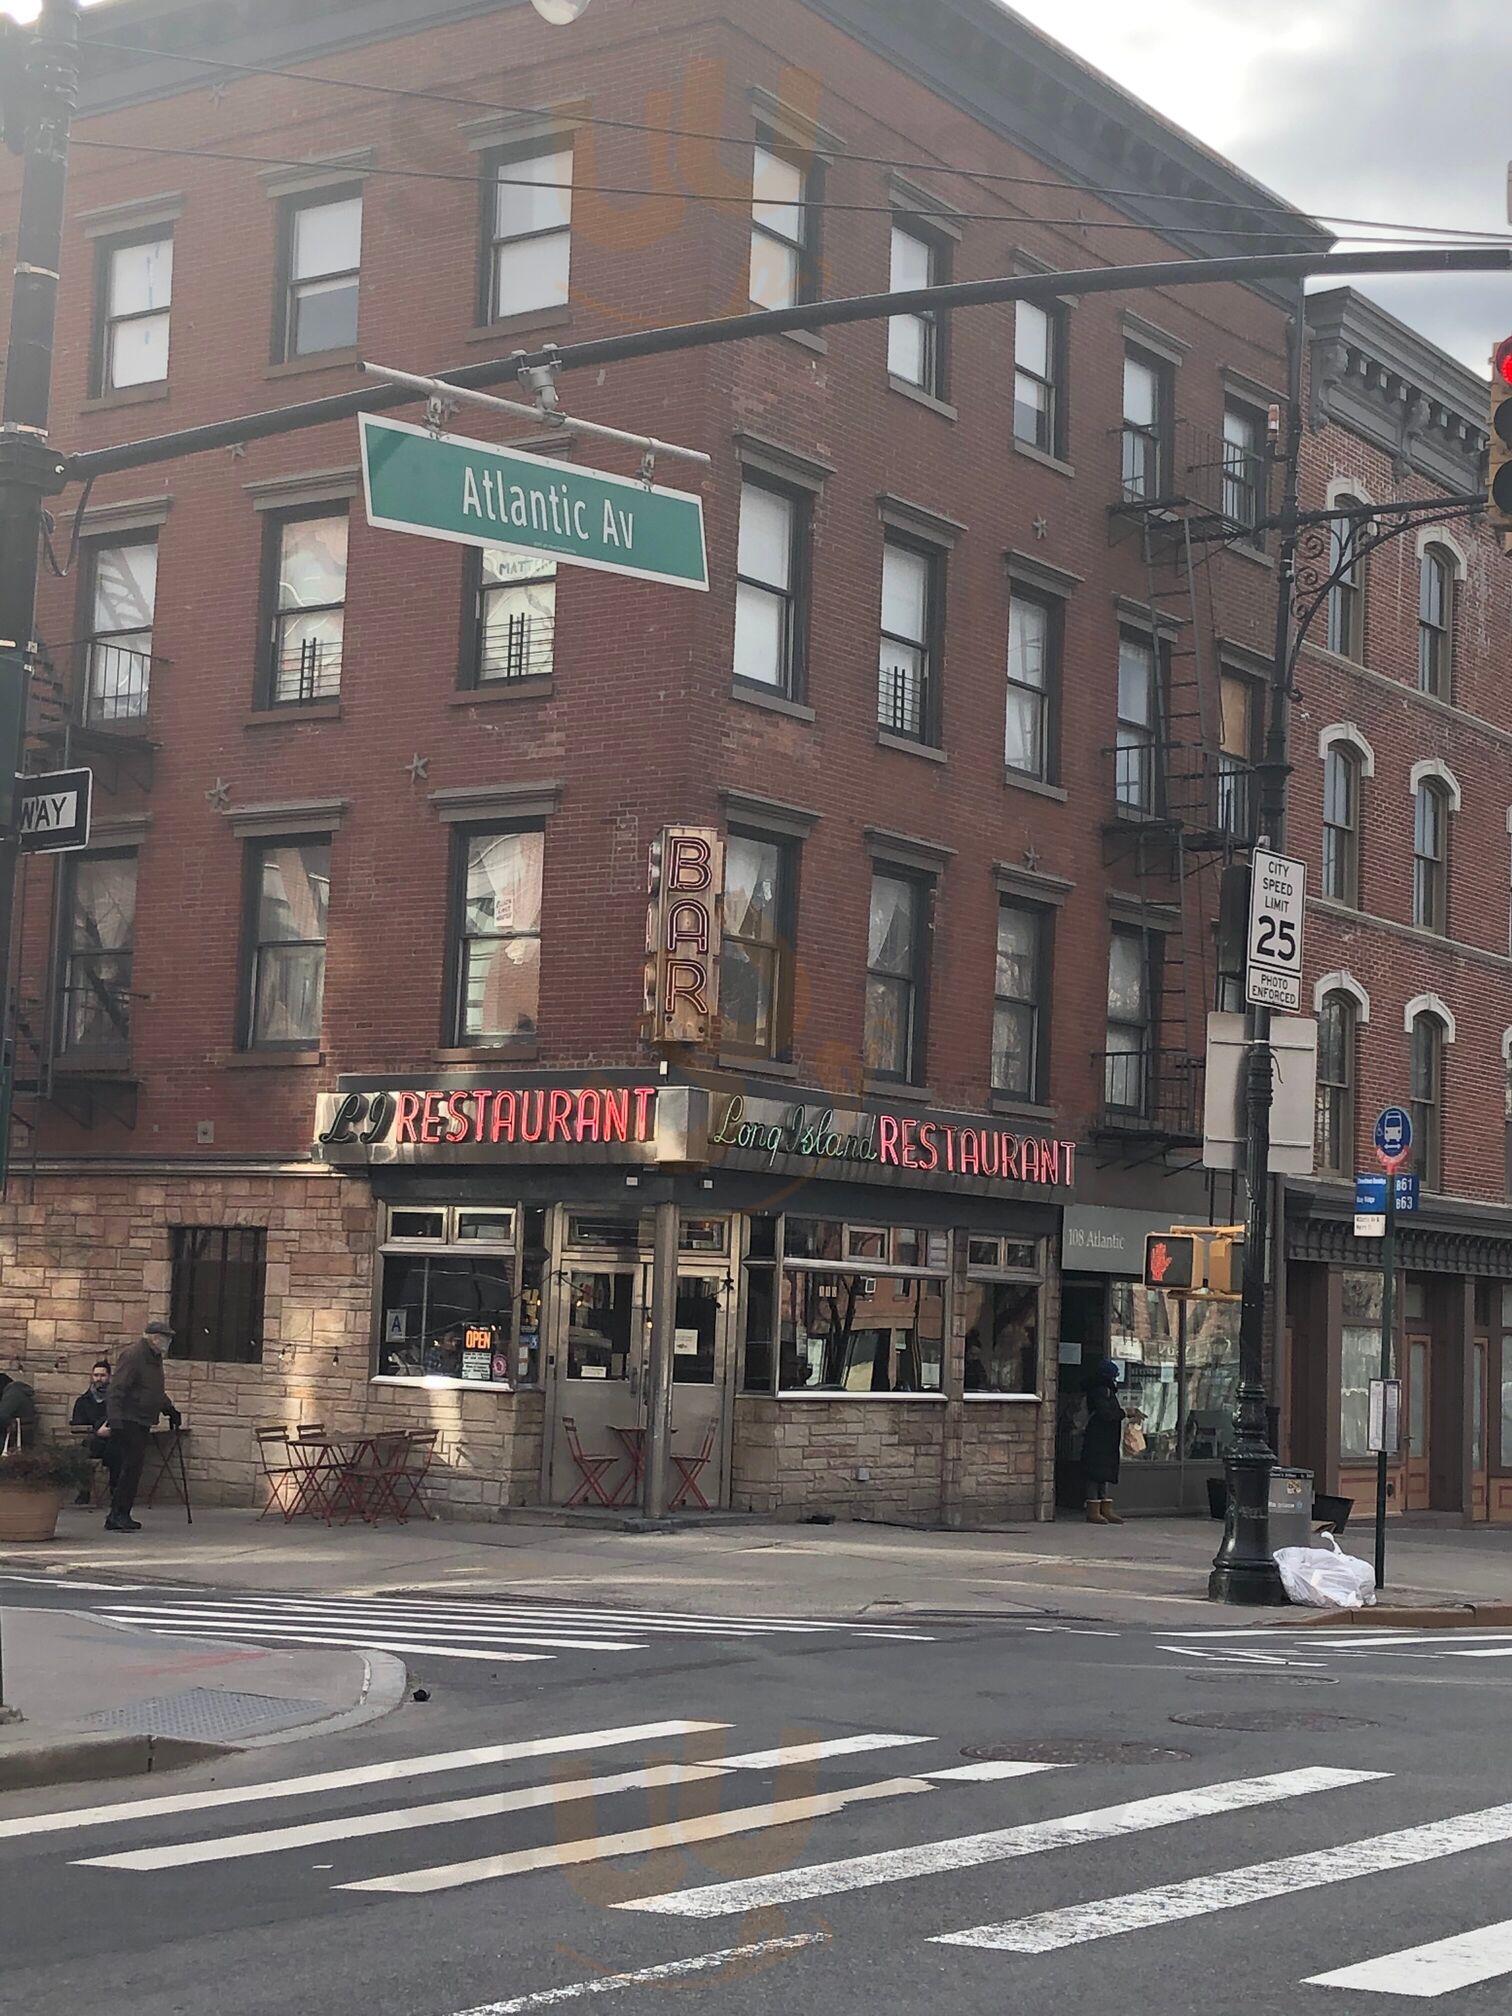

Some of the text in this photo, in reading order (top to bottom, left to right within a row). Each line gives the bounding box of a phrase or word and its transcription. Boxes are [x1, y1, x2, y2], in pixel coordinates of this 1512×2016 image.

[462, 466, 635, 549] Atlantic Av
[20, 797, 67, 831] WAY
[1268, 861, 1290, 878] CITY
[1262, 877, 1293, 897] SPEED
[1264, 895, 1290, 913] LIMIT
[665, 836, 712, 1014] BAR
[1256, 915, 1296, 961] 25
[1260, 974, 1289, 990] PHOTO
[1251, 985, 1296, 1005] ENFORCED
[396, 1087, 656, 1143] RESTAURANT
[714, 1095, 1076, 1187] Long Island RESTAURANT
[1396, 1177, 1413, 1192] B61
[1395, 1196, 1413, 1210] B63
[1067, 1228, 1125, 1250] 108 Atlantic
[391, 1315, 402, 1333] A
[465, 1329, 491, 1349] OPEN
